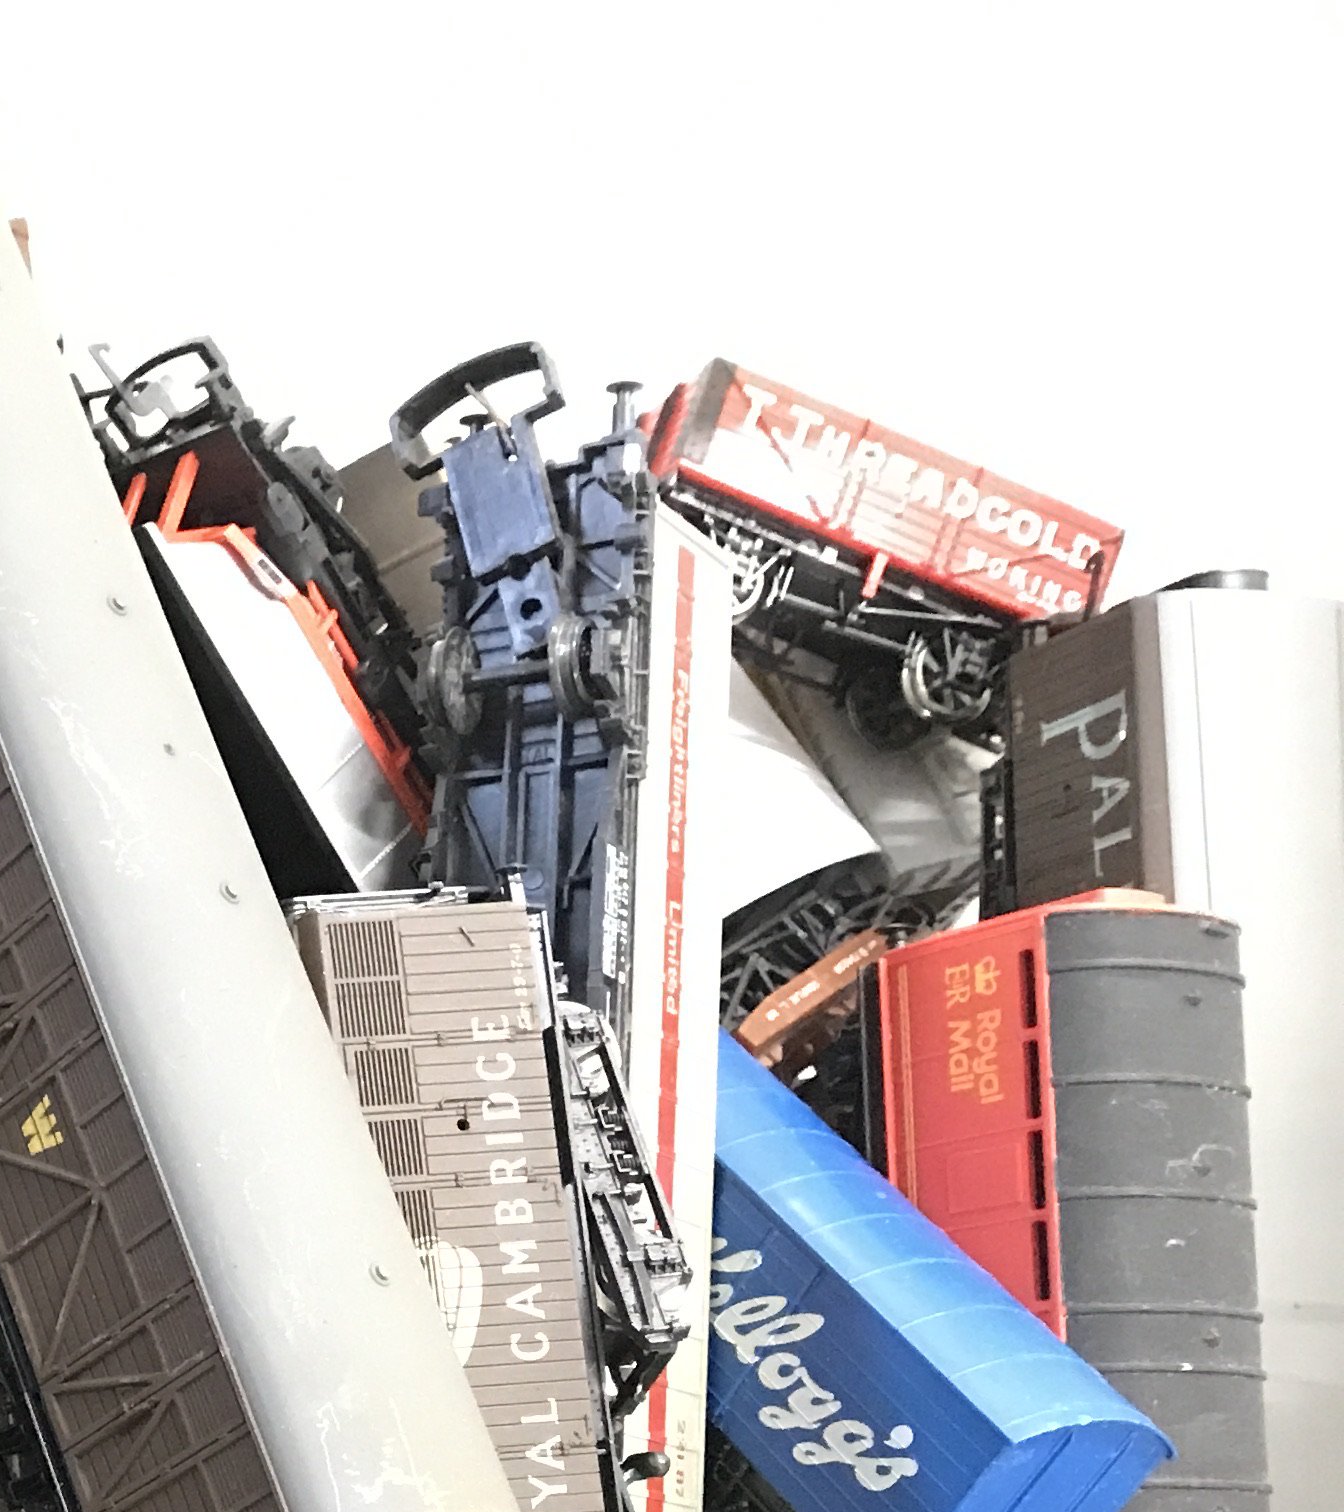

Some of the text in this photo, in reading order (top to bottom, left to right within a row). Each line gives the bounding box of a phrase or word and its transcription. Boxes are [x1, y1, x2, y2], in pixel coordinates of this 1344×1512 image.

[962, 545, 1084, 614] WOKING
[664, 900, 682, 1015] Limited
[948, 1020, 975, 1093] Mail
[976, 1008, 1006, 1104] Royal
[20, 1093, 64, 1157] W
[470, 1013, 552, 1363] CAMBRIDGE
